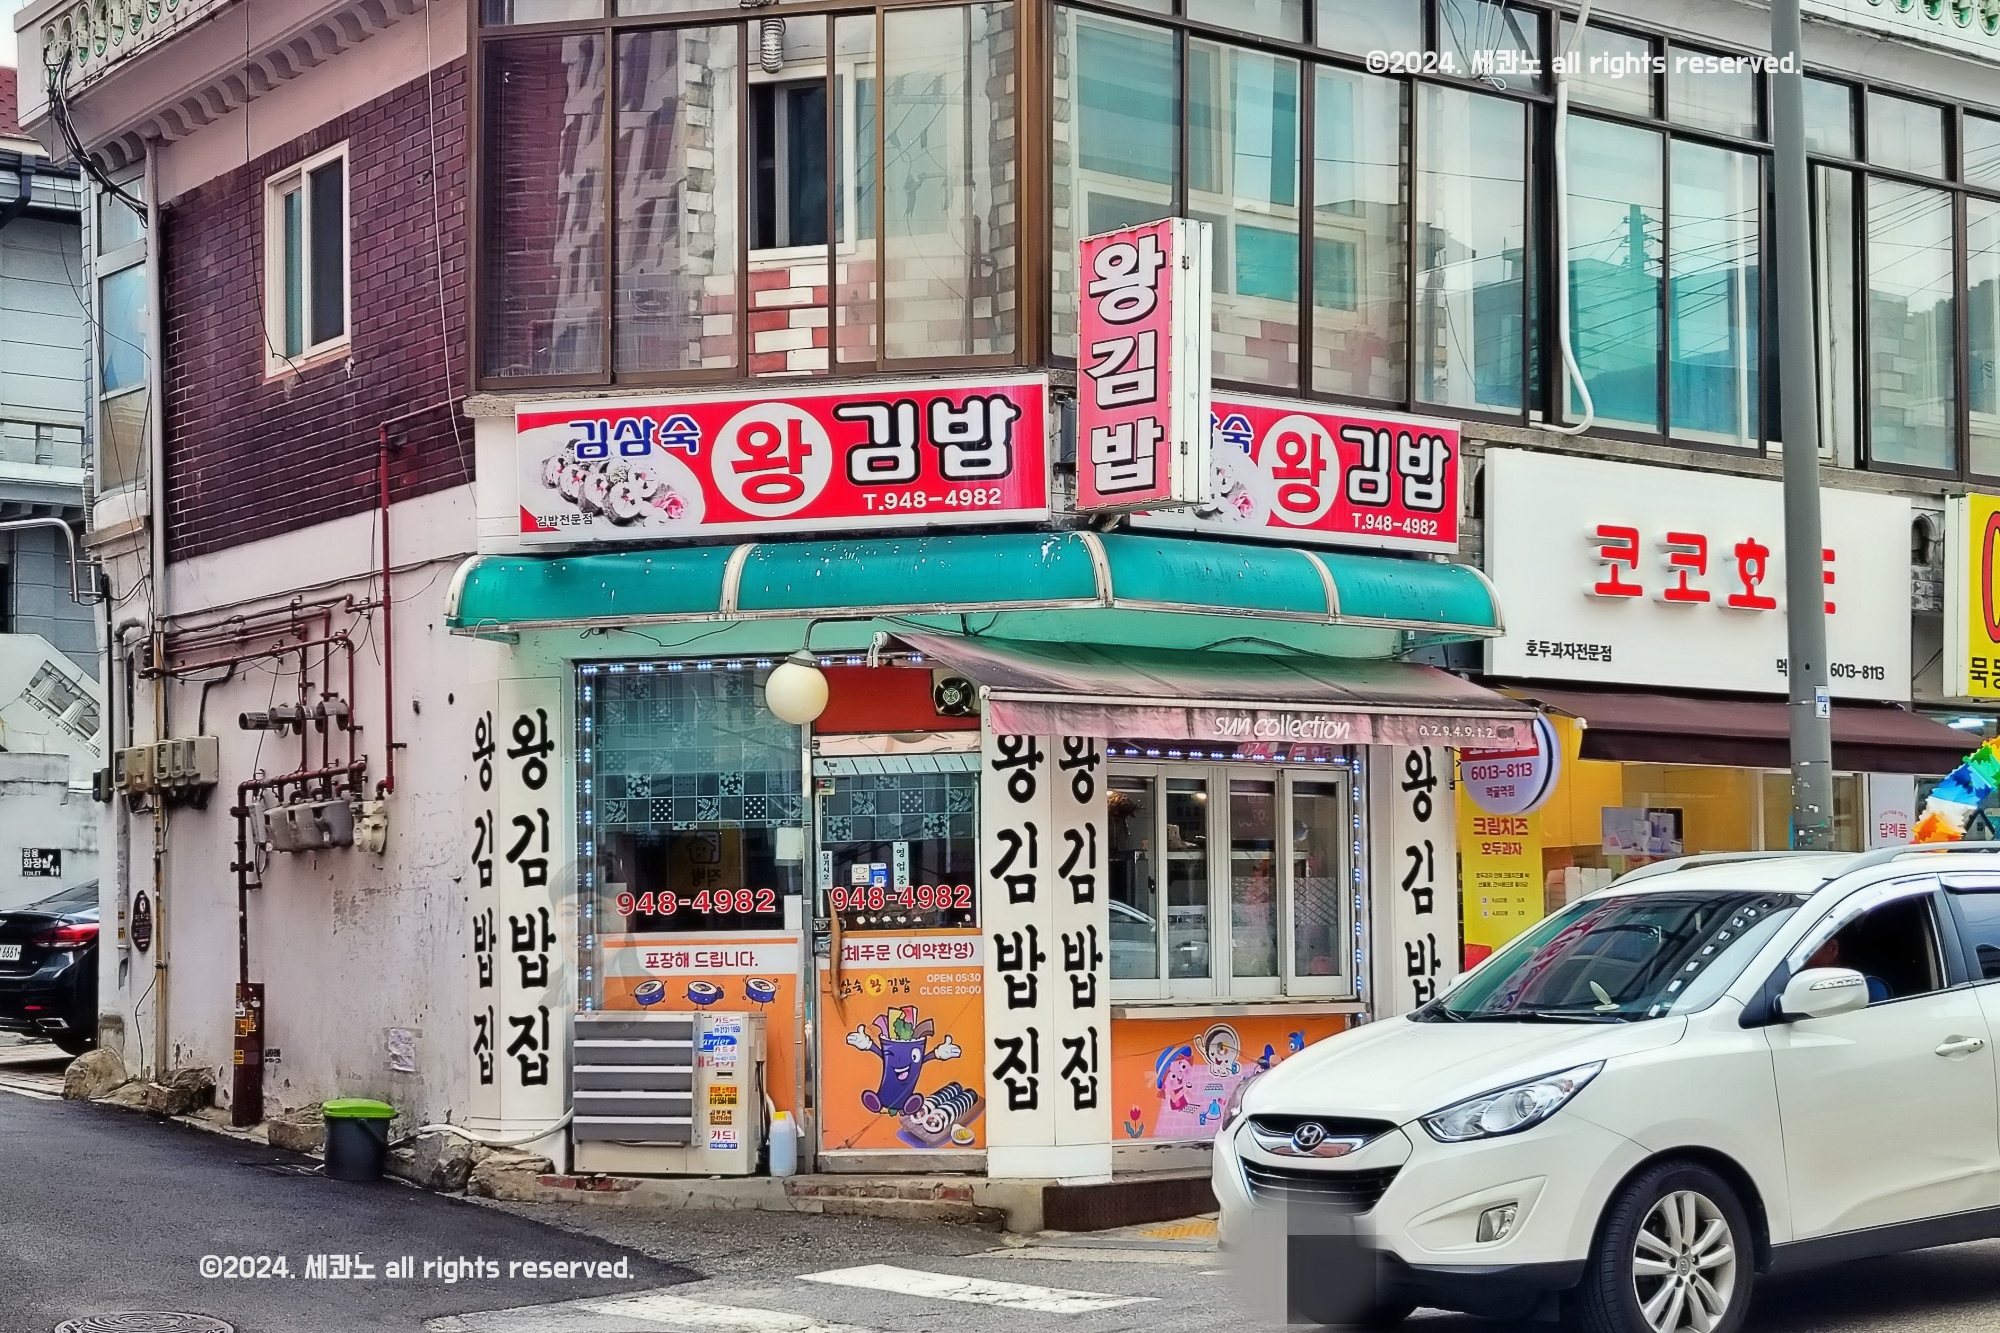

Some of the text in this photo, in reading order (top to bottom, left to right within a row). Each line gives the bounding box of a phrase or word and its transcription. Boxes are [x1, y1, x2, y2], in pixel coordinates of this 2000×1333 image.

[569, 393, 1022, 503] 김삼숙 왕 김밥
[1272, 430, 1329, 512] 왕
[1338, 424, 1451, 511] 김밥
[863, 486, 1003, 512] T.948-4982
[536, 512, 594, 529] 김밥전문점
[1352, 511, 1438, 537] T.948-4982
[1525, 638, 1613, 663] 호두과자전문점
[1830, 662, 1885, 681] 6013-8113
[1471, 762, 1533, 781] 6013-8113
[1473, 817, 1529, 836] 크림치즈
[1879, 822, 1908, 839] 답례품
[1481, 841, 1523, 856] 호두과자
[616, 887, 777, 917] 948-4982
[831, 884, 972, 911] 948-4982
[645, 950, 760, 970] 포장해 드립니다.
[842, 941, 975, 962] 체주문 (예약환영)
[836, 976, 912, 995] 삼숙 왕 김밥
[926, 973, 982, 983] OPEN 05:30
[919, 985, 982, 995] CLOSE 20:00
[703, 1036, 731, 1046] arrier
